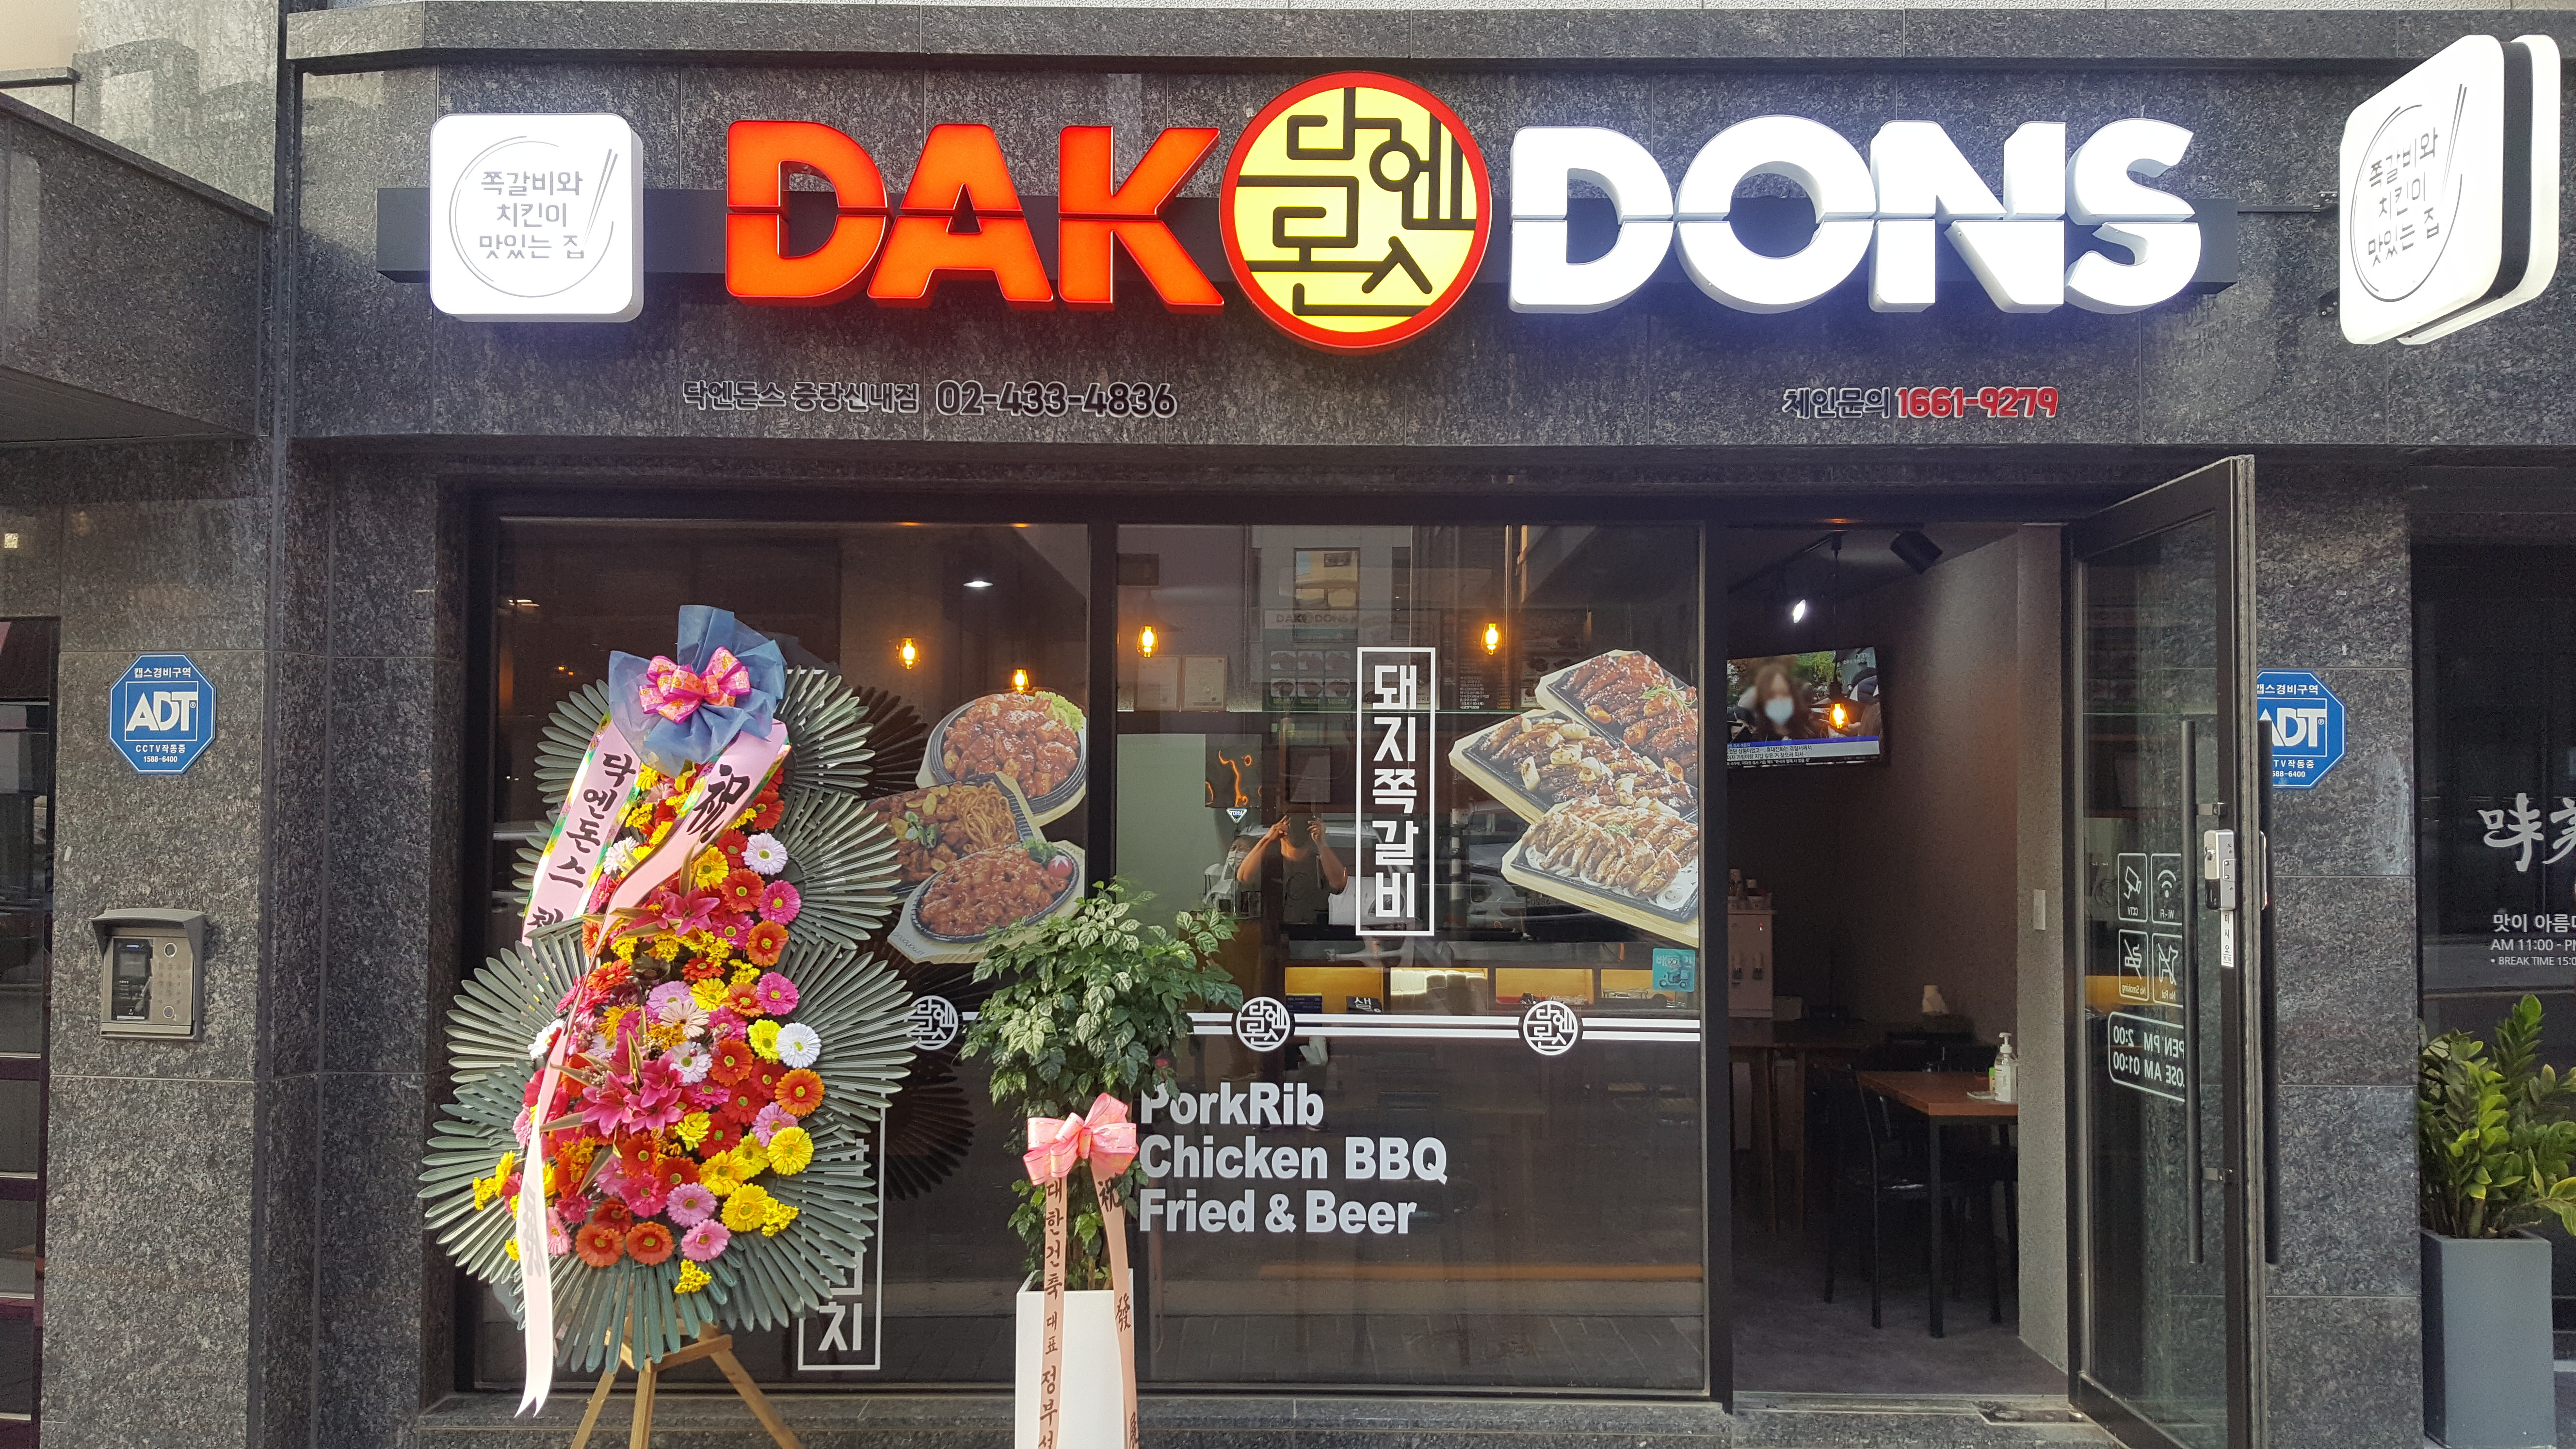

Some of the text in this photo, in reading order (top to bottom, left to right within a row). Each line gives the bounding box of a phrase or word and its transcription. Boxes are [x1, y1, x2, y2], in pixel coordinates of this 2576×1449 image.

[2369, 127, 2438, 187] 쪽갈비와
[481, 171, 583, 196] 쪽갈비와
[2379, 171, 2426, 220] 치킨이
[497, 203, 566, 227] 치킨이
[725, 120, 1224, 311] DAK
[1510, 115, 2202, 313] DONS
[479, 234, 585, 259] 맛있는 집
[2368, 207, 2439, 267] 맛있는 집
[682, 379, 1178, 419] 닥엔돈스 중랑신내점 02-433-4836
[1783, 386, 2059, 419] 체인문의 1661-9279
[134, 667, 192, 678] 캡스경비구역
[126, 691, 198, 731] ADT
[135, 744, 186, 754] CCTV작동중
[2273, 759, 2315, 769] TV작동중
[686, 763, 751, 844] 祝
[1372, 665, 1419, 918] 돼지쪽갈비
[2494, 914, 2528, 933] 맛이
[2491, 939, 2514, 951] AM
[2518, 939, 2554, 951] 11:00
[2498, 956, 2530, 966] BREAK
[2531, 956, 2555, 966] TIME
[1140, 1082, 1324, 1126] PorkRib
[1139, 1134, 1448, 1185] Chicken BBQ
[1139, 1189, 1417, 1234] Fried & Beer
[1045, 1311, 1058, 1355] 대표
